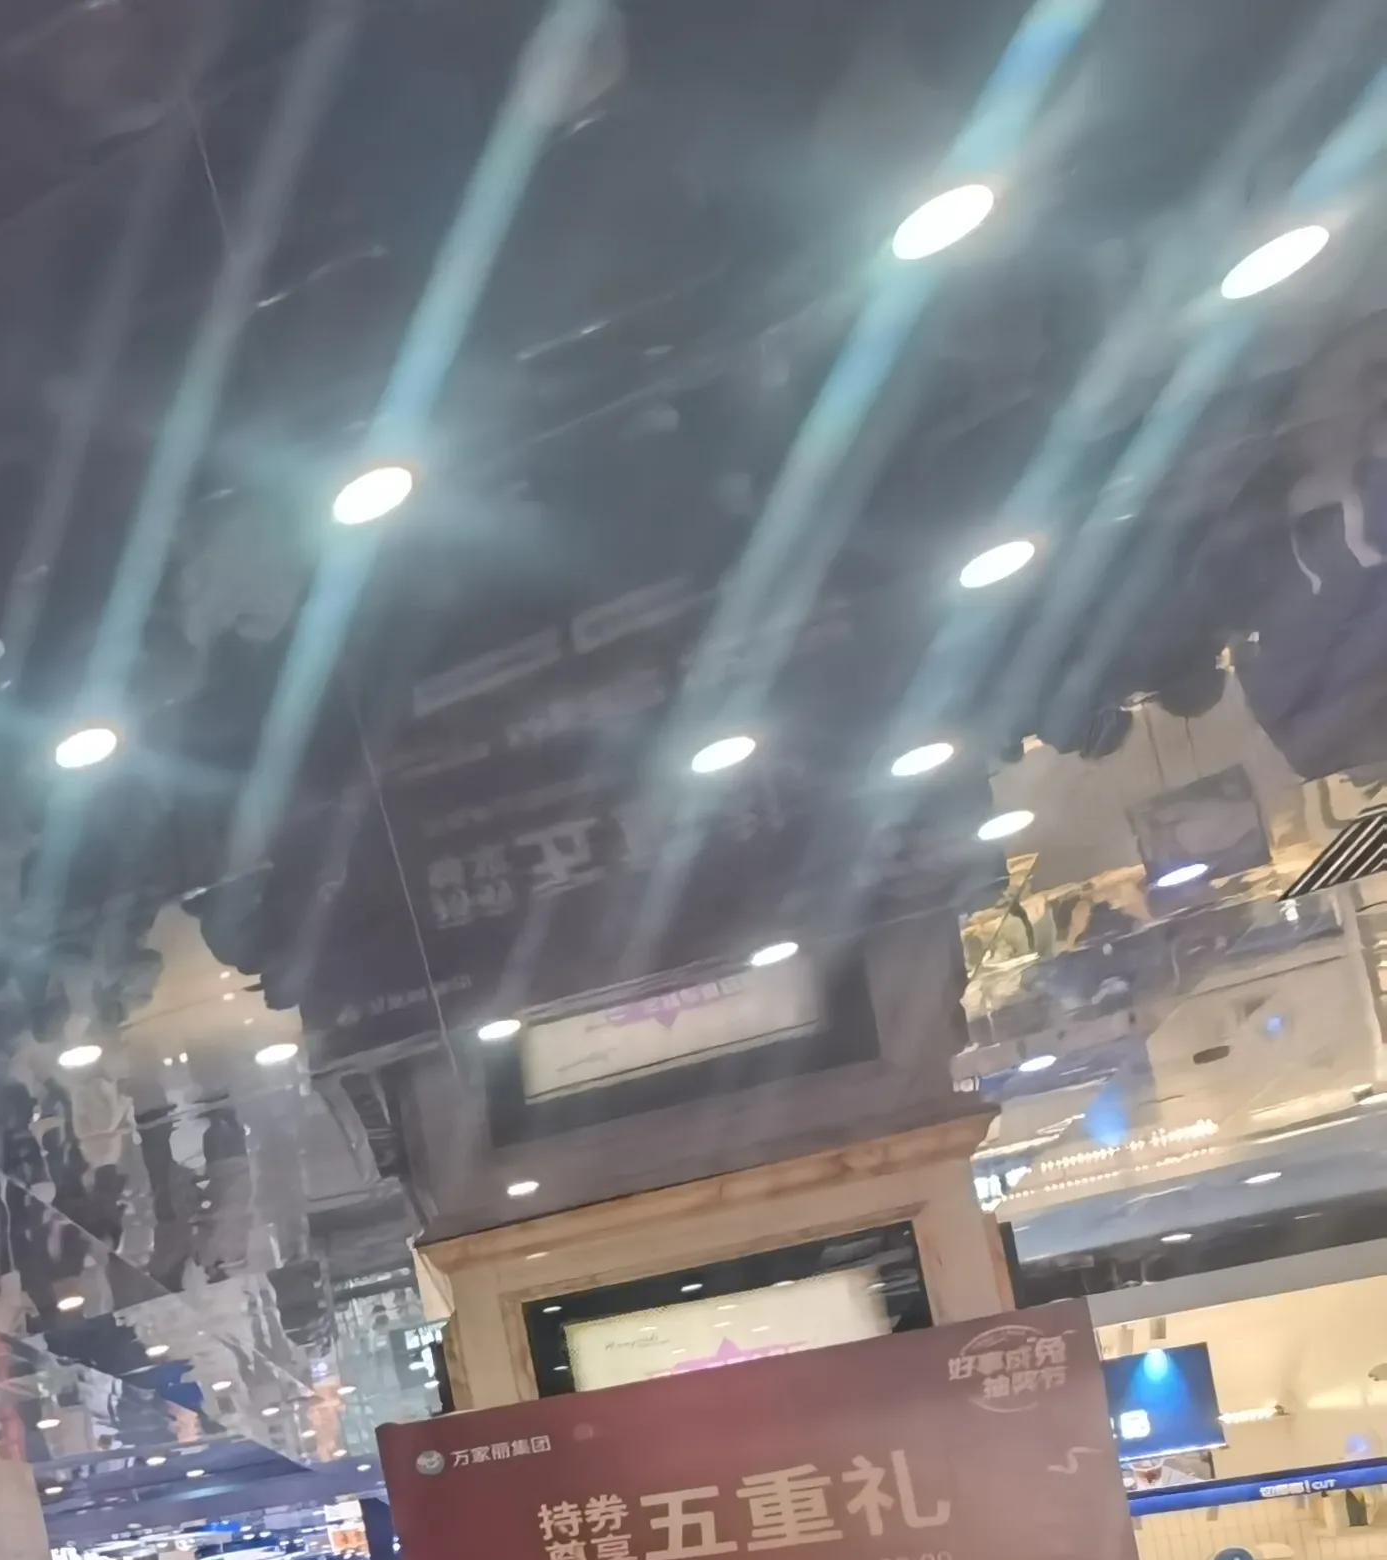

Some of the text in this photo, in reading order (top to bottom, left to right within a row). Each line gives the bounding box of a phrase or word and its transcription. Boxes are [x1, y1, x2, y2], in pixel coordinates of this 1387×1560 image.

[450, 1434, 552, 1468] 万家丽集团
[537, 1493, 629, 1541] 持券
